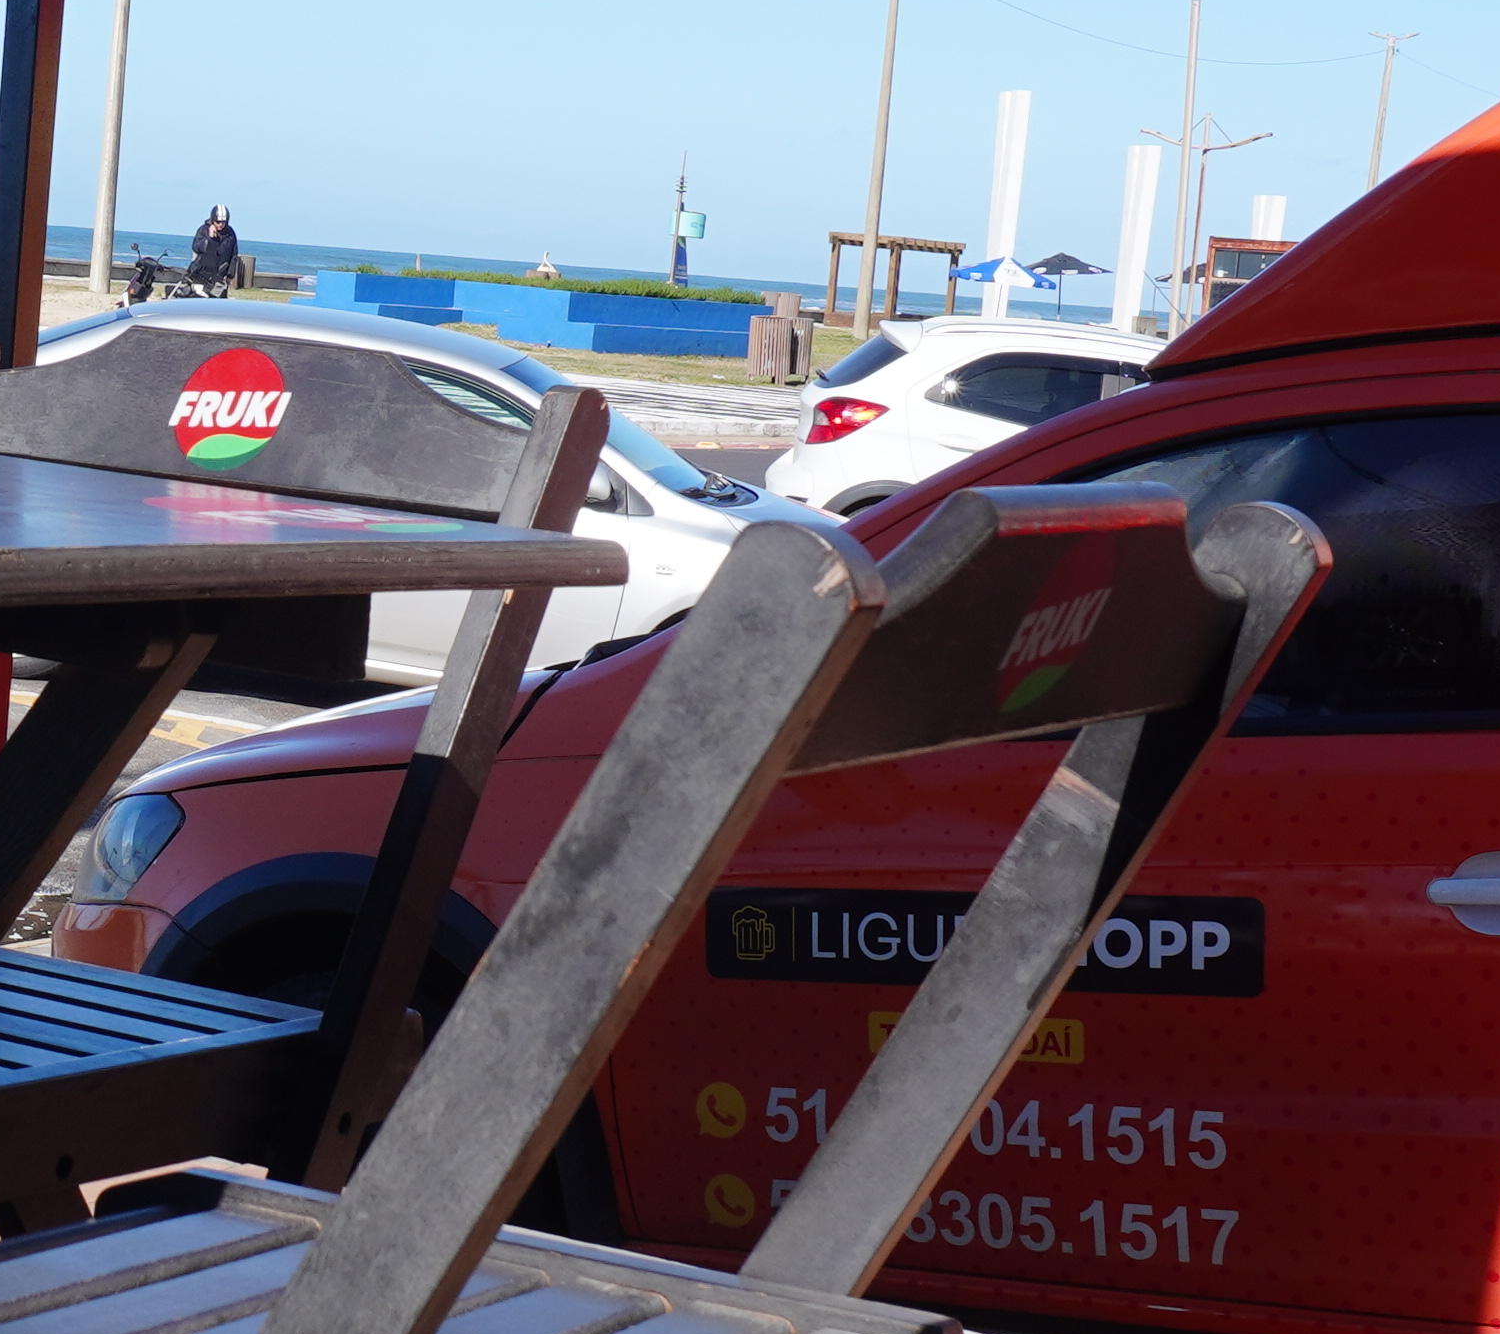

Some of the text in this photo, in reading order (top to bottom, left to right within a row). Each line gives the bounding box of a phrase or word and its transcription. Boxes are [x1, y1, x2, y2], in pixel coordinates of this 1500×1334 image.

[169, 390, 292, 429] FRUKI
[999, 587, 1111, 671] FRUKI
[1077, 917, 1232, 971] OPP
[765, 1086, 828, 1144] 51
